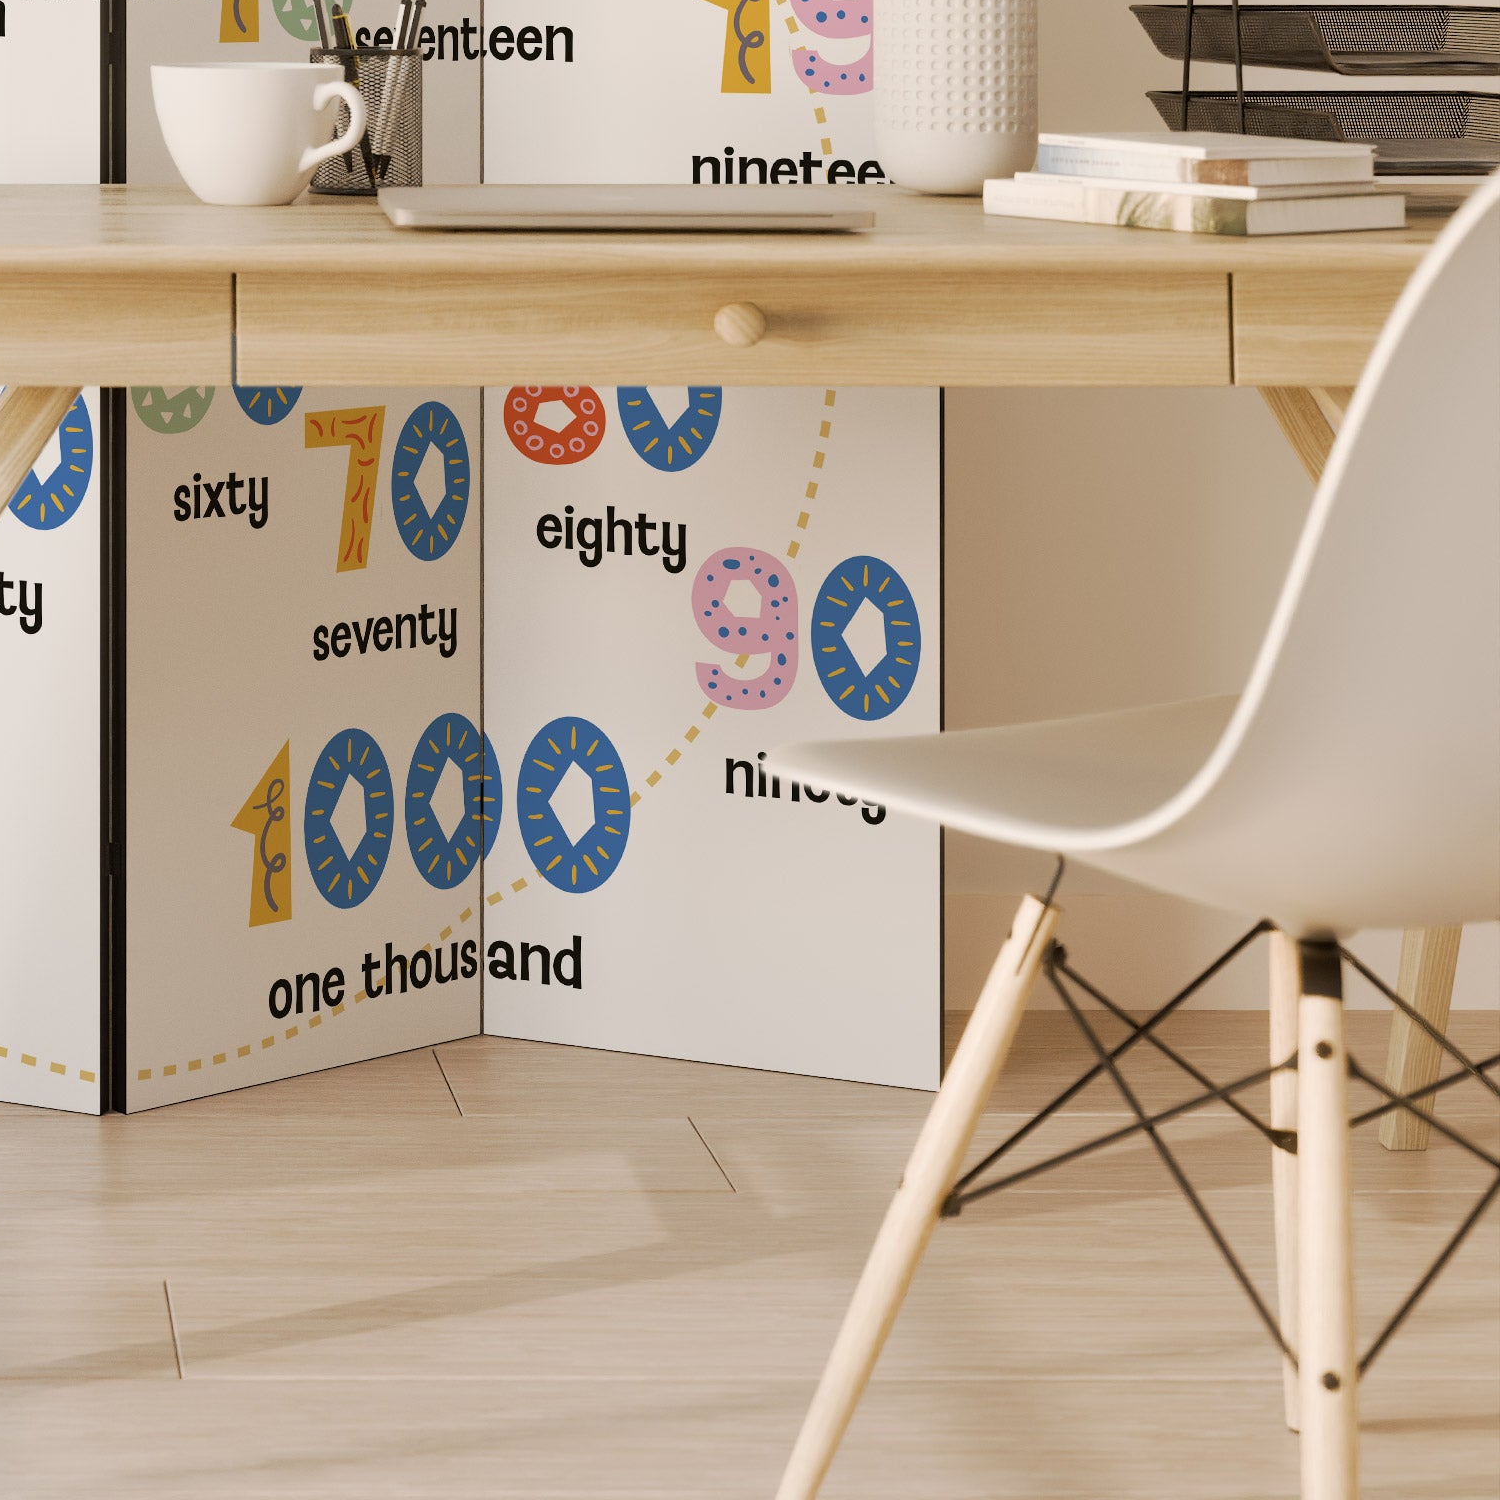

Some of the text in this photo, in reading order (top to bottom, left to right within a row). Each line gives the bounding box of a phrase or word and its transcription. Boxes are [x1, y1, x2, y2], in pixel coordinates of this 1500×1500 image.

[356, 18, 574, 62] seenteen
[692, 147, 896, 184] ninetee
[174, 473, 269, 528] sixty
[305, 401, 470, 573] 70
[537, 506, 687, 573] eighty
[313, 604, 458, 658] seventy
[691, 546, 921, 721] 90
[231, 712, 632, 928] 1000
[269, 936, 582, 1019] one thousand
